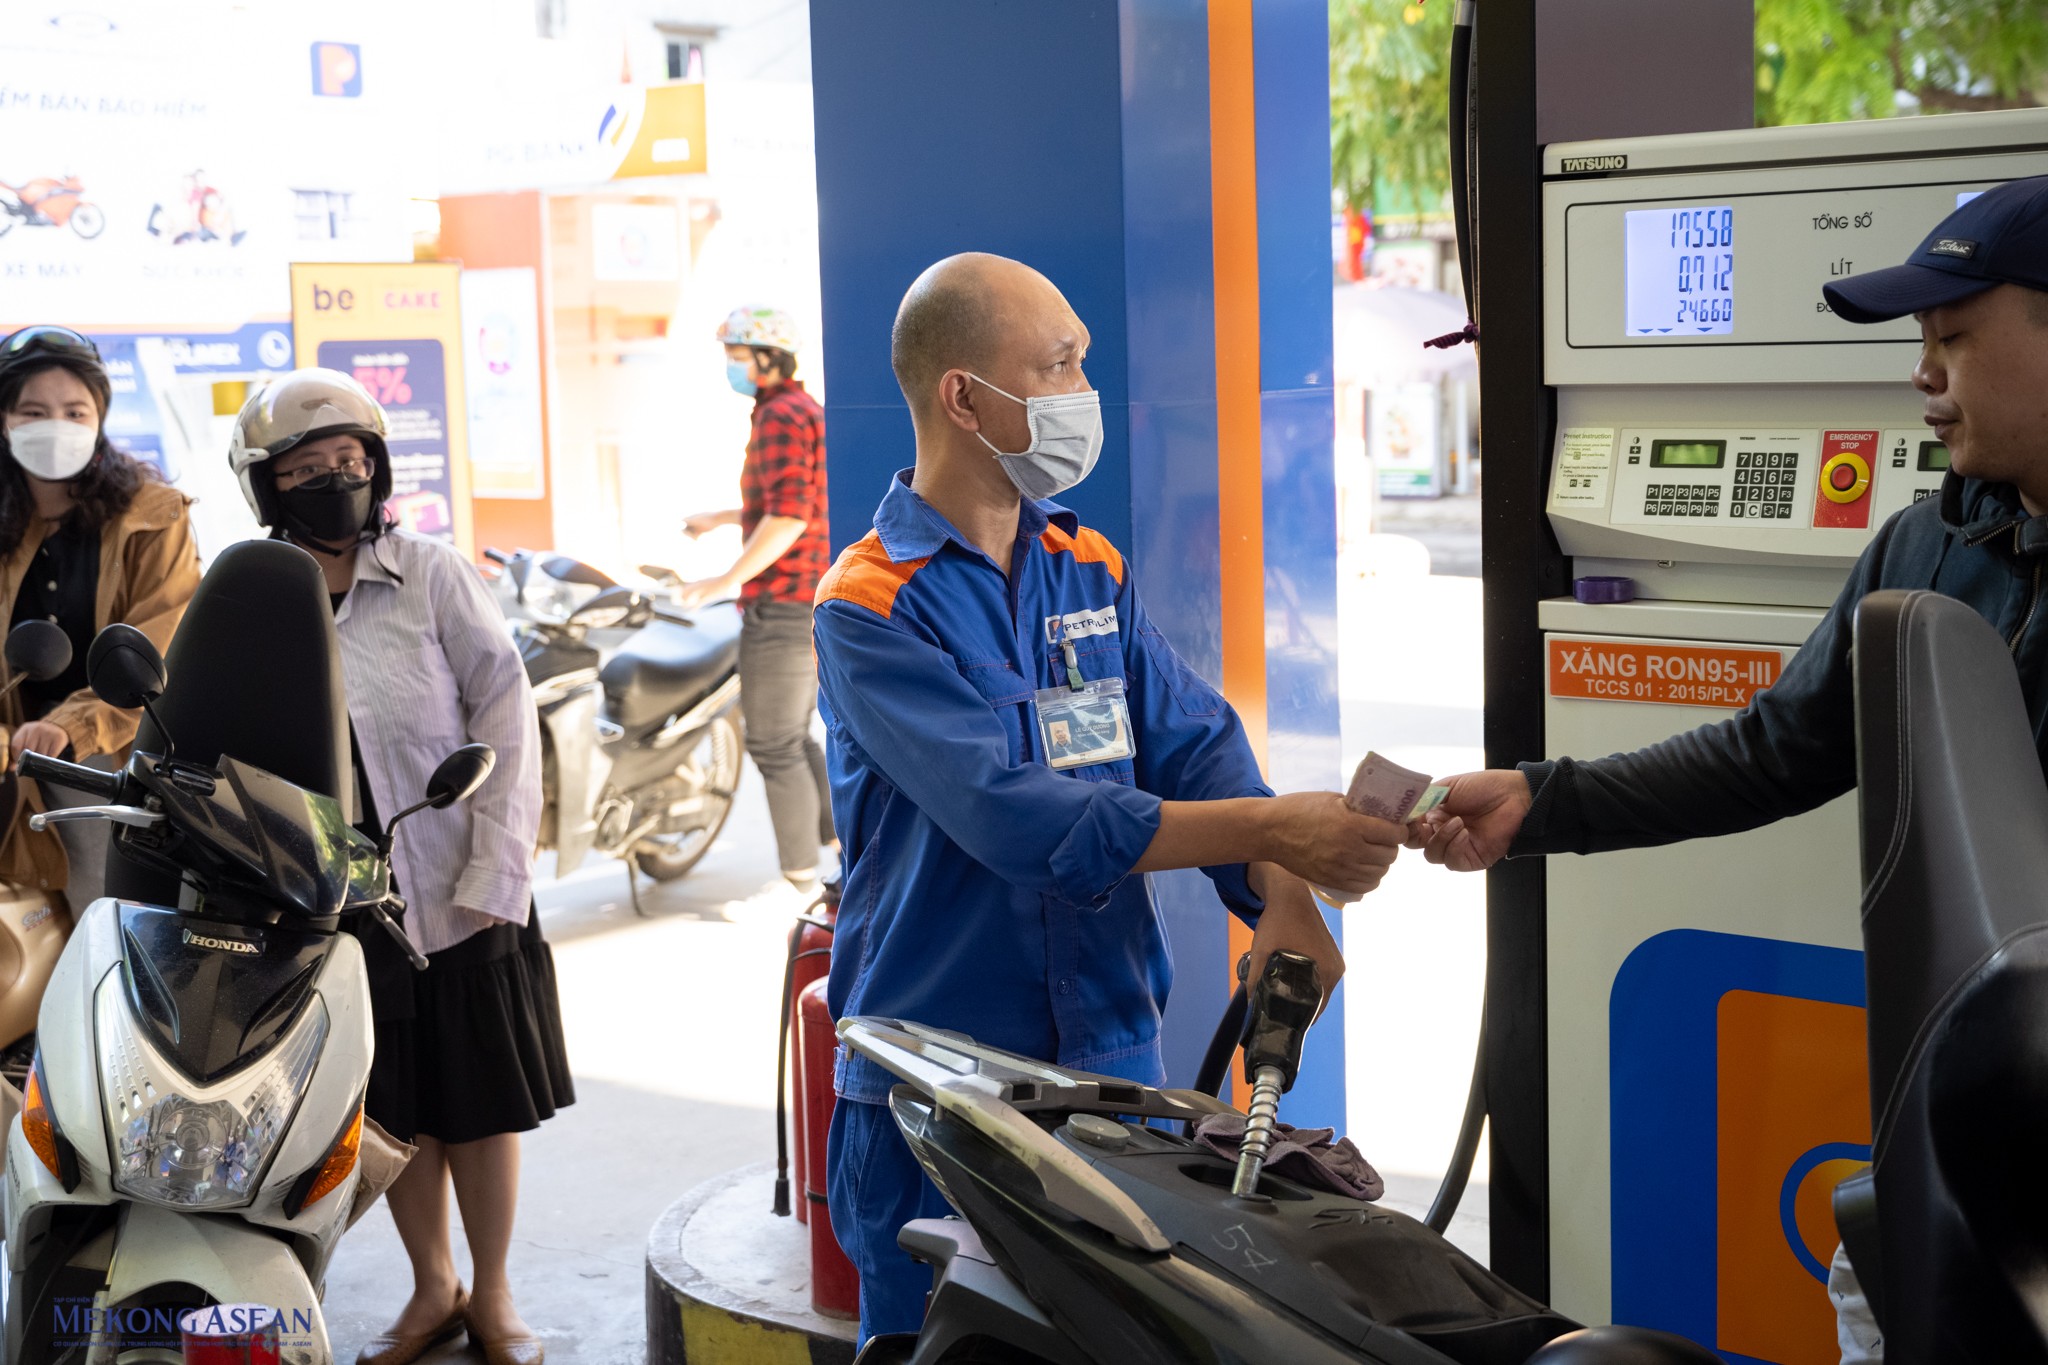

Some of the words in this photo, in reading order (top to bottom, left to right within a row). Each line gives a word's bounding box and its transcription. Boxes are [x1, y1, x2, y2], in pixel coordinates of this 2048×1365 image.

[1564, 156, 1625, 171] TATSUNO
[1671, 209, 1733, 248] 17558
[1812, 213, 1849, 230] TỔNG
[1854, 211, 1874, 228] SỐ
[1678, 254, 1733, 295] 0,712
[1831, 258, 1853, 275] LÍT
[312, 283, 354, 311] be
[383, 290, 441, 309] CAKE
[1677, 298, 1733, 323] 24660
[1829, 433, 1873, 441] EMERGENCY
[1840, 442, 1860, 450] STOP
[1740, 455, 1749, 466] 7
[1755, 455, 1764, 466] 8
[1770, 455, 1779, 466] 9
[1785, 456, 1795, 465] F1
[1737, 471, 1746, 482] 4
[1753, 472, 1761, 482] 5
[1769, 472, 1777, 483] 6
[1783, 473, 1794, 482] F2
[1647, 487, 1659, 497] P1
[1662, 487, 1674, 497] P2
[1677, 488, 1689, 497] P3
[1692, 488, 1704, 497] P4
[1707, 488, 1719, 498] P5
[1736, 488, 1743, 499] 1
[1751, 488, 1760, 499] 2
[1766, 488, 1775, 500] 3
[1781, 489, 1792, 499] F3
[1645, 504, 1657, 513] P6
[1660, 504, 1672, 513] P7
[1675, 504, 1687, 513] P8
[1690, 504, 1702, 514] P9
[1704, 505, 1719, 514] P10
[1733, 504, 1741, 516] 0
[1748, 505, 1758, 516] C
[1779, 506, 1790, 515] F4
[1063, 615, 1116, 631] PETRLIM
[1560, 646, 1637, 677] XĂNG
[1646, 655, 1771, 686] RON95-III
[1584, 678, 1630, 696] TCCS
[1634, 681, 1652, 697] 01
[1668, 683, 1746, 704] 2015/PLX
[190, 934, 259, 953] HONDA
